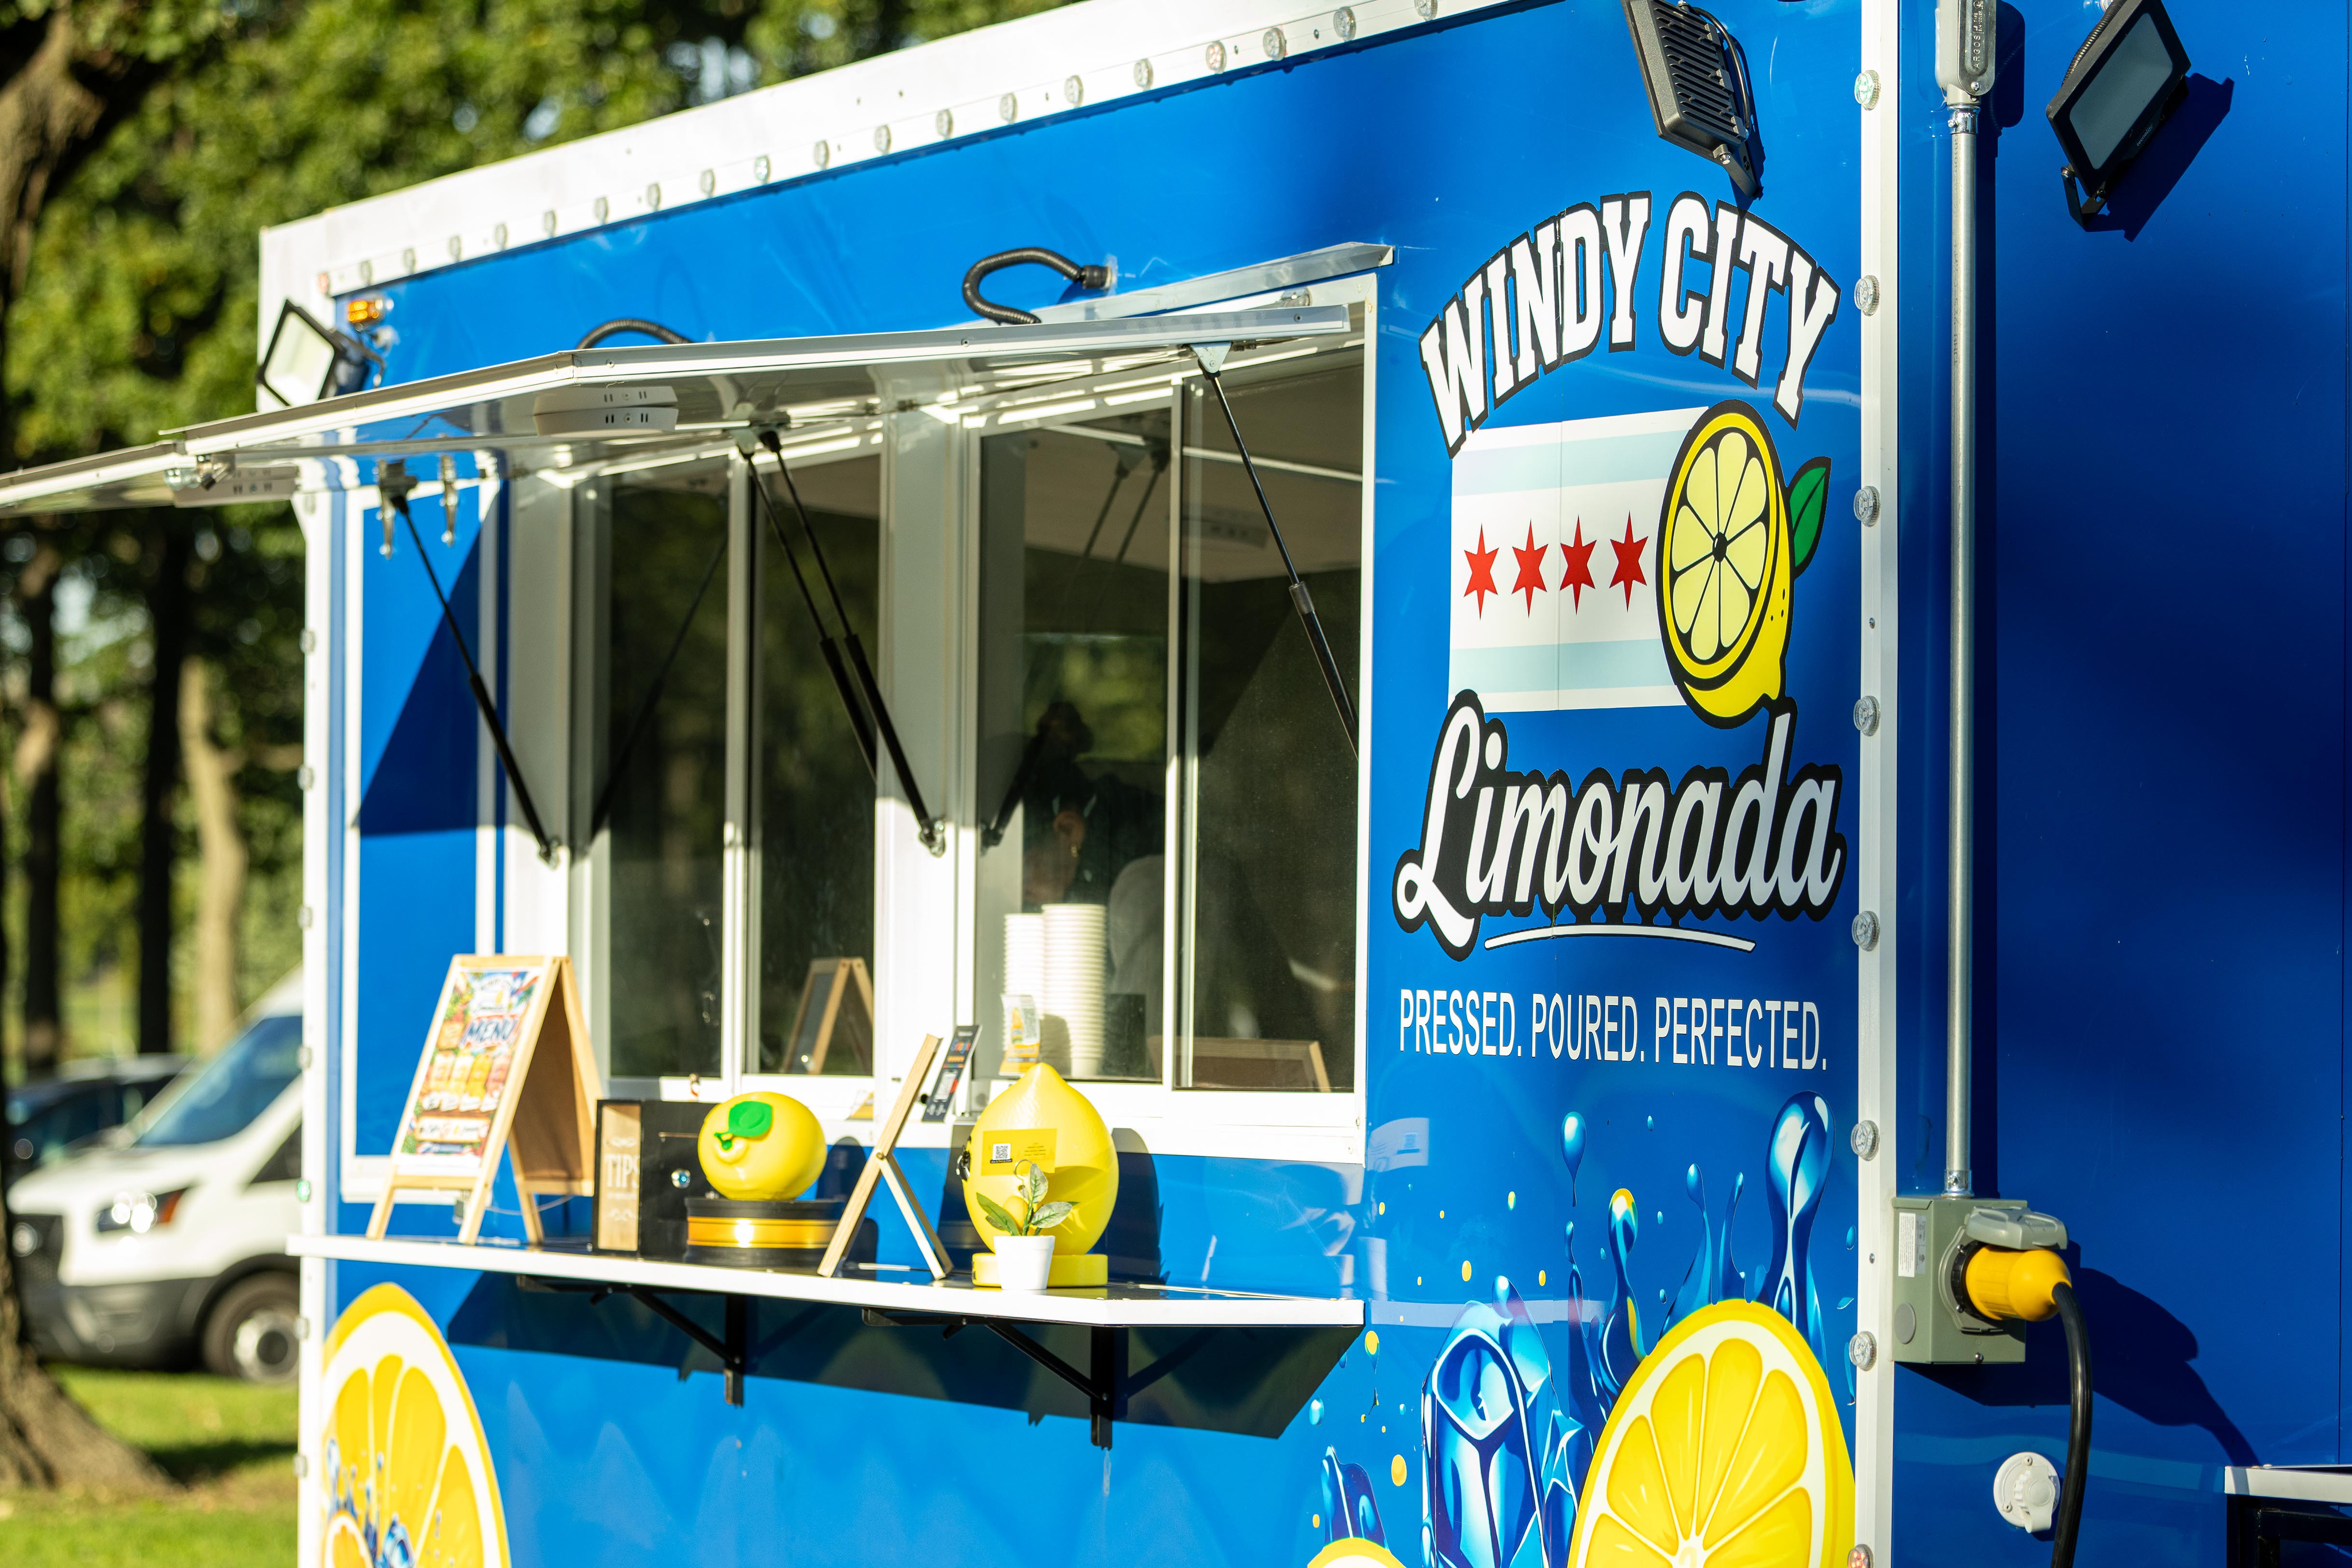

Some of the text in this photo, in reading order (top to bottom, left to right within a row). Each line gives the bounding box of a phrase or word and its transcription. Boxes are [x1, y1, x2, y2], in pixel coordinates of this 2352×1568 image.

[1419, 193, 1839, 454] WINDY CITY
[1395, 700, 1844, 952] Limonada
[460, 1017, 518, 1045] MENU
[1400, 989, 1827, 1071] PRESSED. POURED. PERFECTED.
